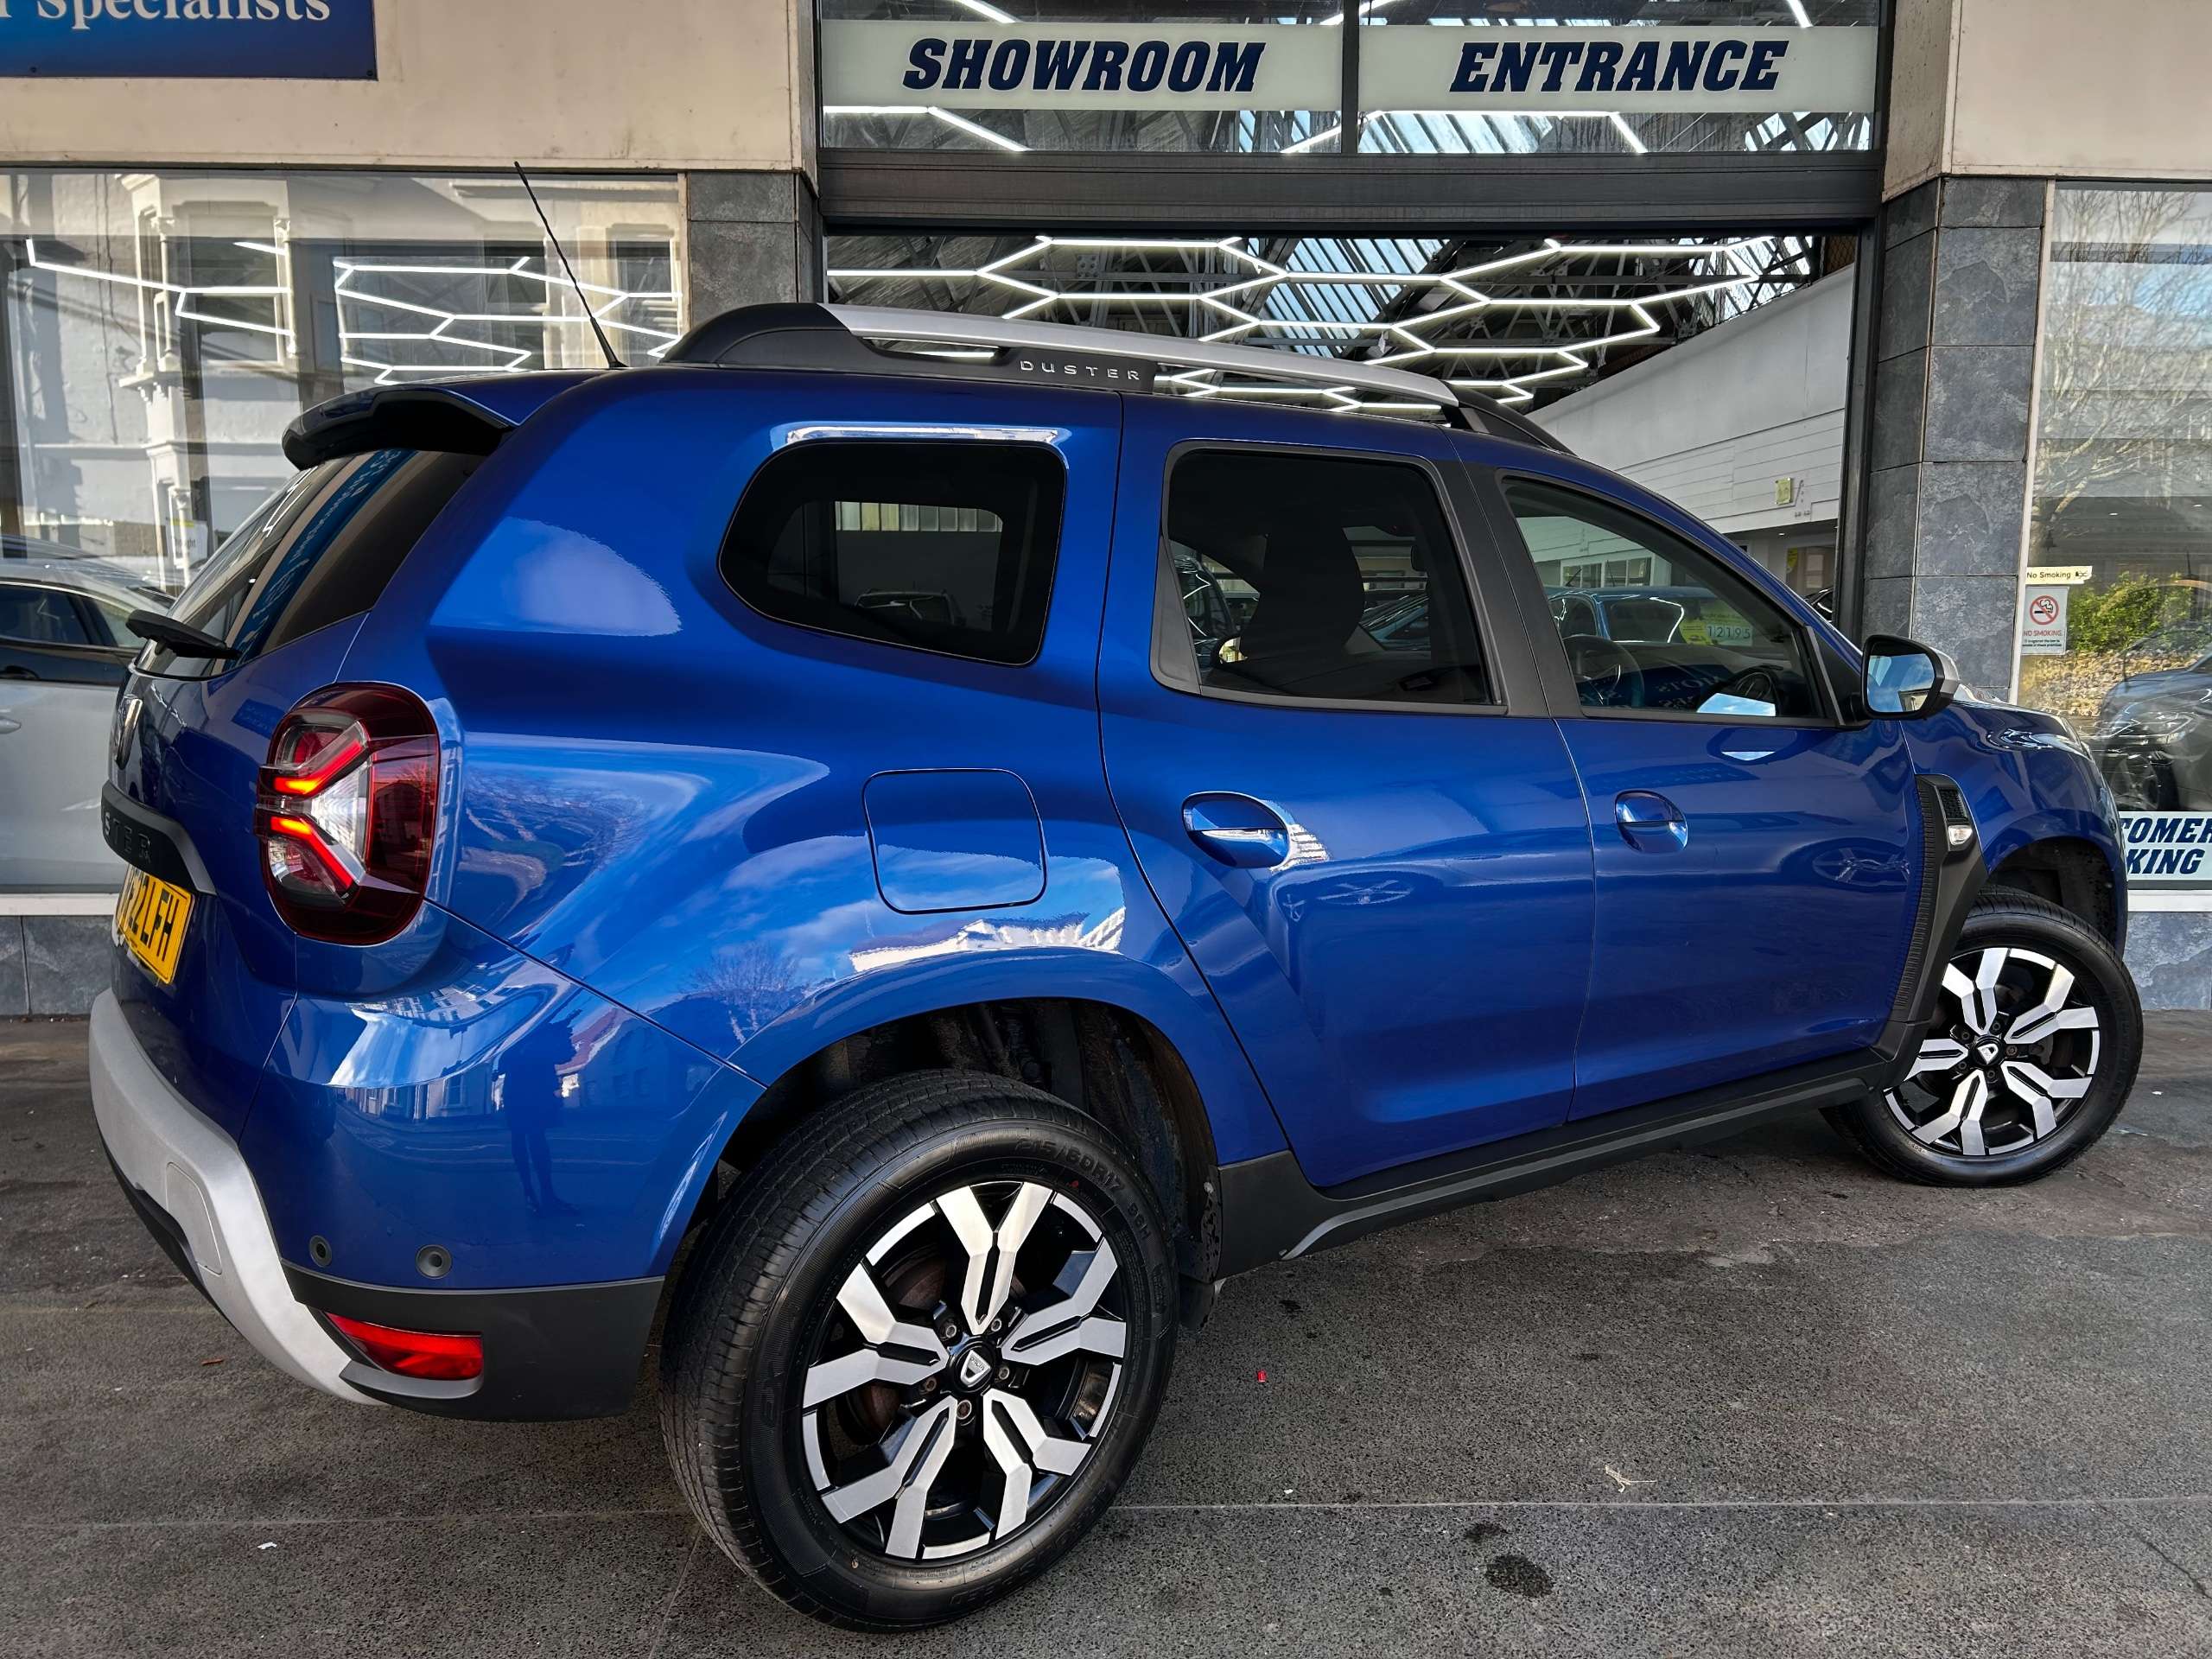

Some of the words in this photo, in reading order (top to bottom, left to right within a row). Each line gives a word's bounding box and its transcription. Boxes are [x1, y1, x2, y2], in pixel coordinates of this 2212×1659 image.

[902, 38, 1266, 92] SHOWROOM
[1449, 40, 1789, 92] ENTRANCE
[1020, 360, 1140, 380] DUSTER
[1707, 625, 1751, 639] 12195
[2126, 849, 2206, 874] KING
